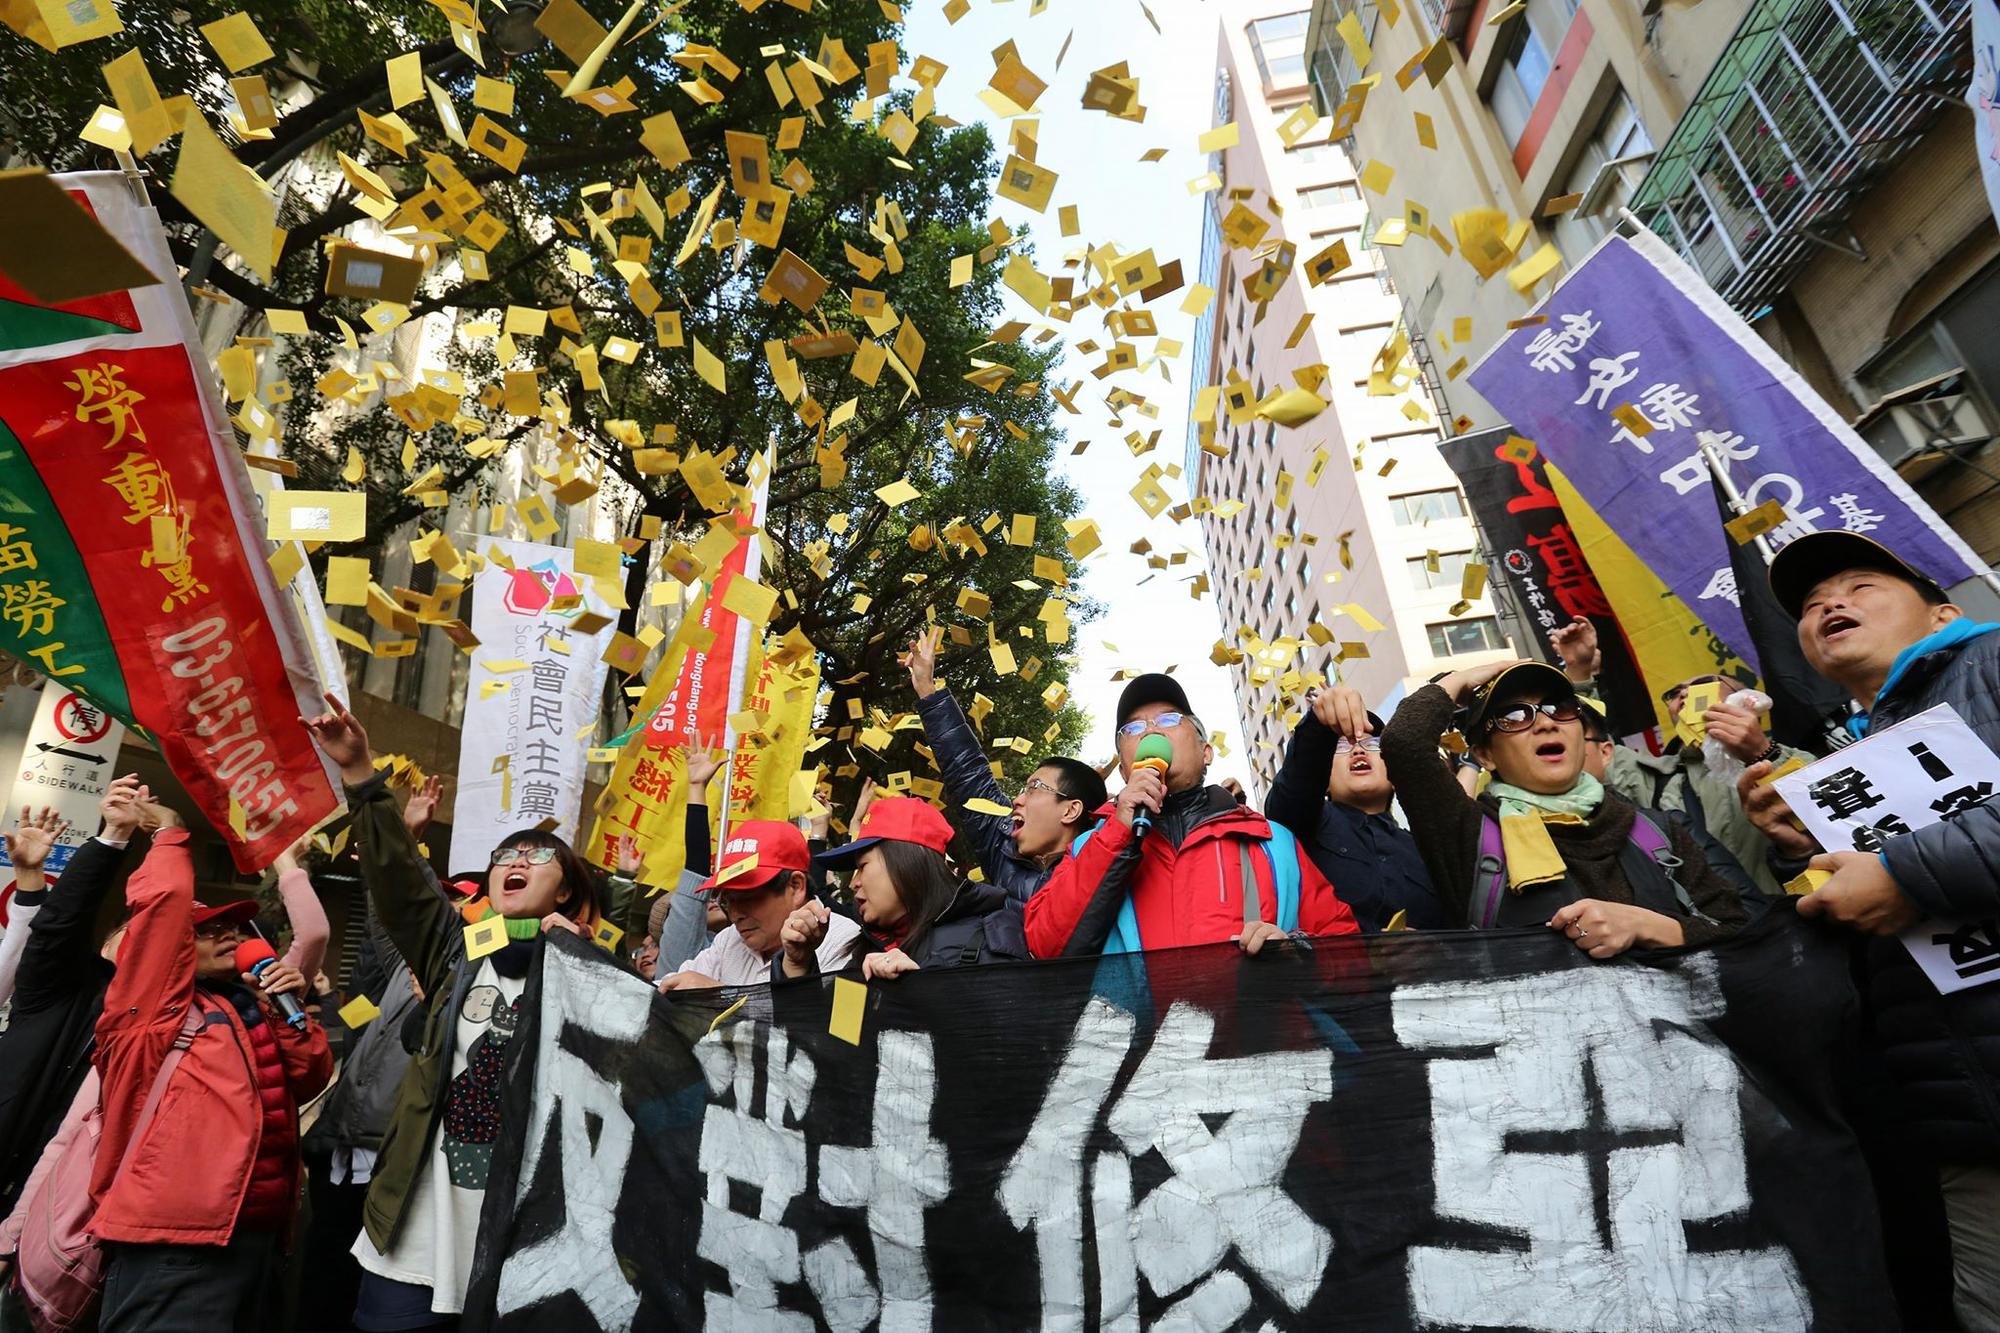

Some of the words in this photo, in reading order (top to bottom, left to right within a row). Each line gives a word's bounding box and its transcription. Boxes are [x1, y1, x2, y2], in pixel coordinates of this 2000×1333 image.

[63, 362, 210, 613] 勞動黨
[0, 523, 90, 697] 苗勞工
[513, 624, 531, 662] Soci
[70, 703, 100, 731] 停
[161, 615, 298, 842] 03-6570655
[517, 620, 572, 820] 社會民主黨
[36, 759, 99, 782] 人行道
[37, 775, 104, 795] SIDEWALK
[64, 827, 88, 839] ZONE
